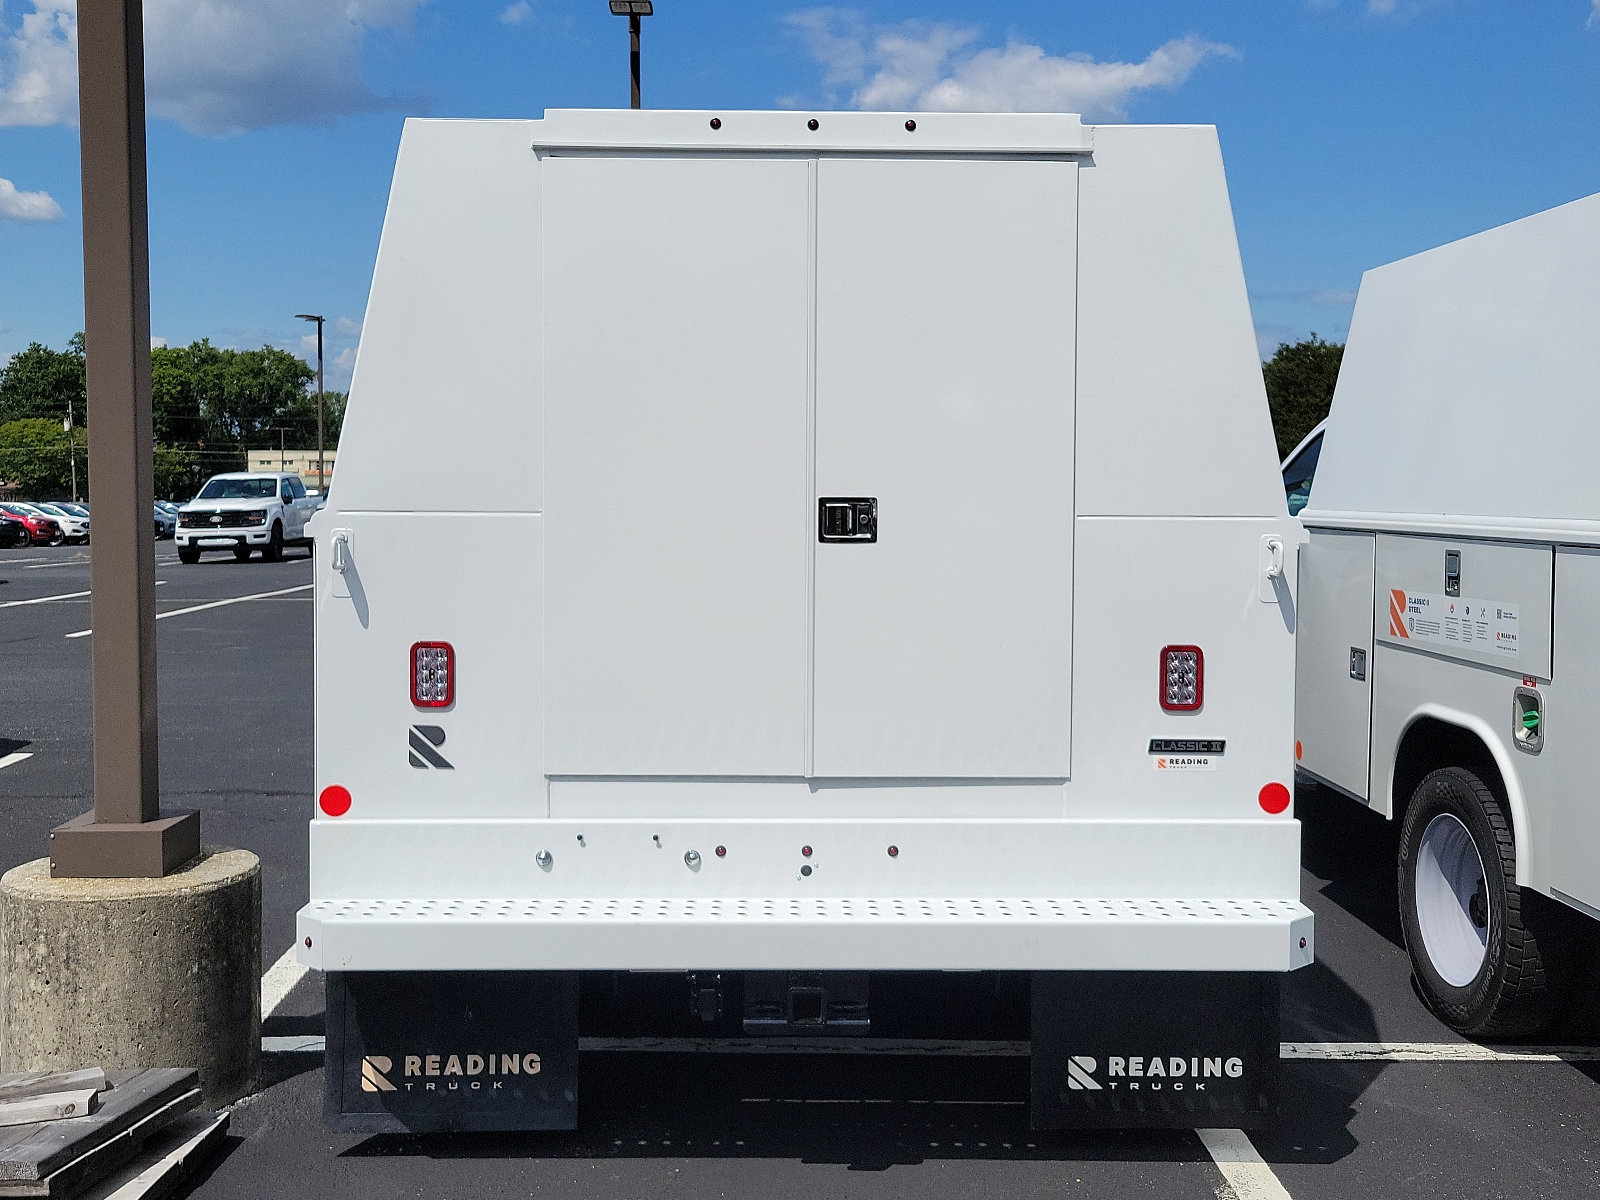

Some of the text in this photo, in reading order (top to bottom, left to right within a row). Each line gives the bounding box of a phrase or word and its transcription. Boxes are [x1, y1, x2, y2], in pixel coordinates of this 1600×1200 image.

[1408, 597, 1426, 606] CLASSIC
[1408, 606, 1422, 614] STEEL
[1152, 741, 1222, 752] CLASSIC II
[404, 1053, 541, 1076] READING
[1108, 1056, 1243, 1078] READING
[404, 1081, 503, 1091] TRUCK
[1109, 1082, 1206, 1091] TRUCK
